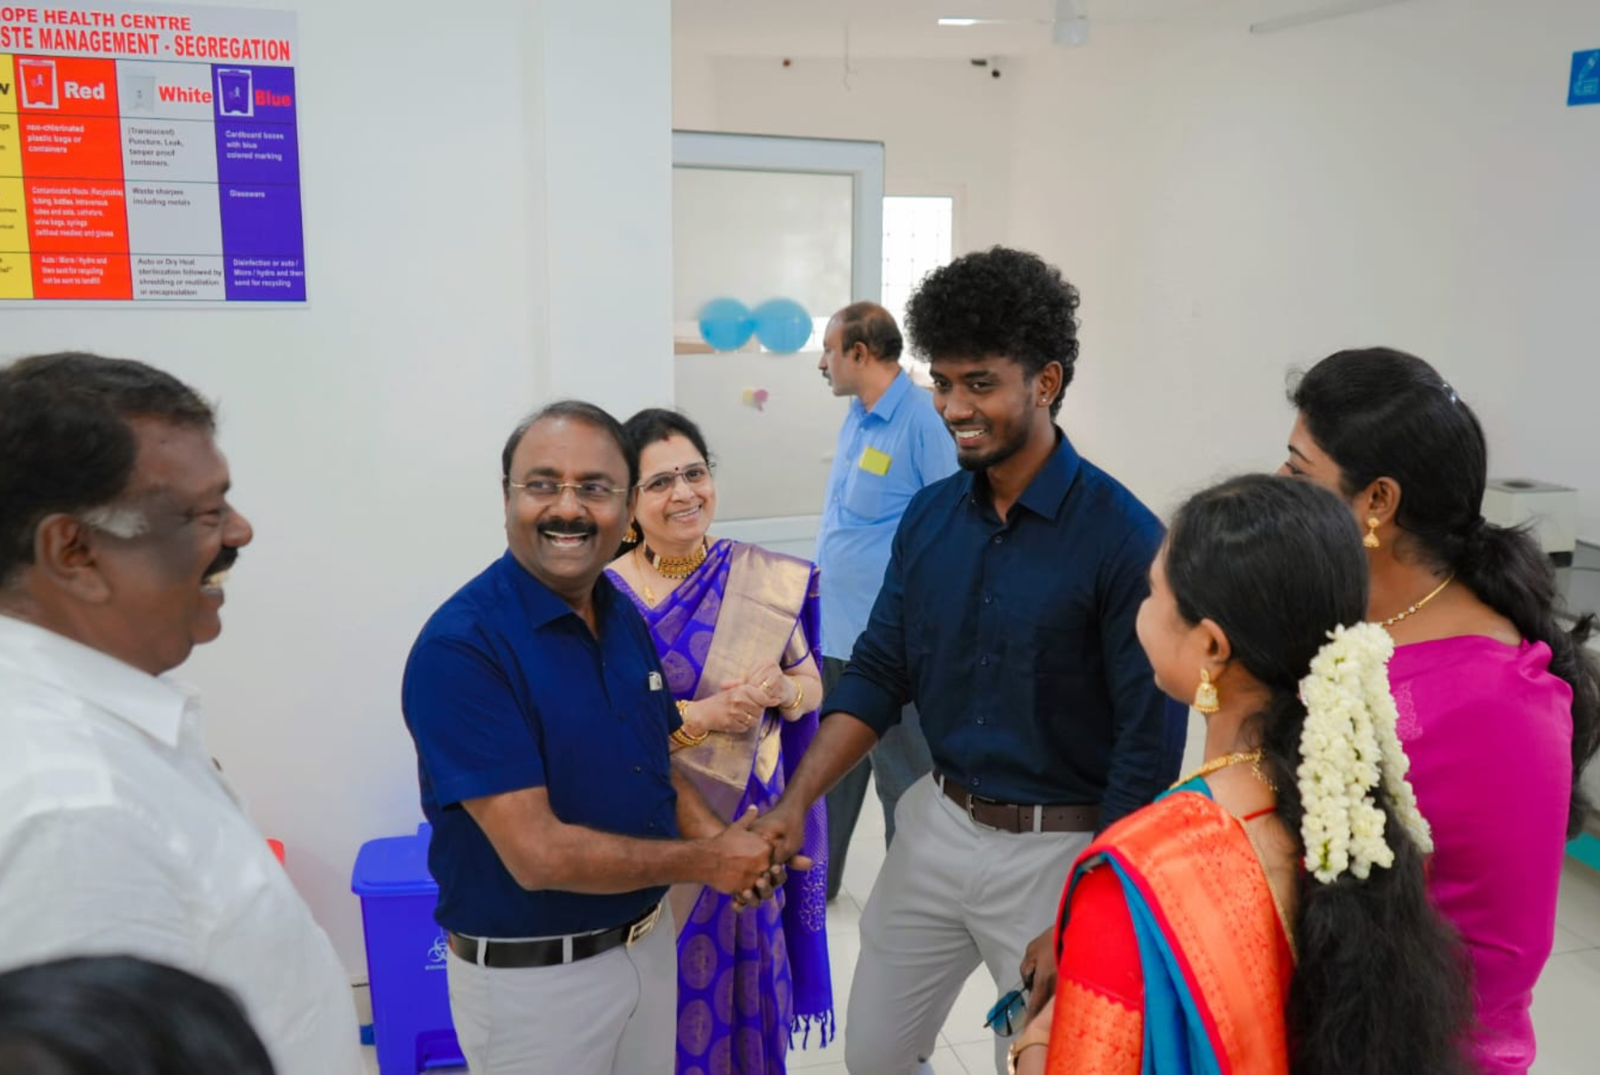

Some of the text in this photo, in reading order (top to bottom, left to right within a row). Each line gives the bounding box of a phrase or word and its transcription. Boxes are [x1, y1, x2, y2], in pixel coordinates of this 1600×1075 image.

[44, 10, 115, 27] HEALTH
[121, 14, 191, 31] CENTRE
[0, 25, 34, 48] STE
[39, 28, 159, 55] MANAGEMENT
[174, 34, 290, 61] SEGREGATION
[64, 81, 105, 100] Red
[158, 86, 212, 103] White
[255, 90, 292, 107] Blue
[26, 124, 84, 133] non-chlorinated
[27, 134, 52, 143] plastic
[54, 135, 72, 144] bags
[225, 130, 284, 140] Cardboard boxes
[27, 145, 67, 153] containers
[155, 149, 175, 157] proof
[254, 152, 282, 161] marking
[229, 189, 266, 198] Glassware
[133, 198, 166, 206] including
[165, 258, 178, 266] Dry
[233, 259, 270, 267] Disinfection
[262, 279, 291, 288] recycling
